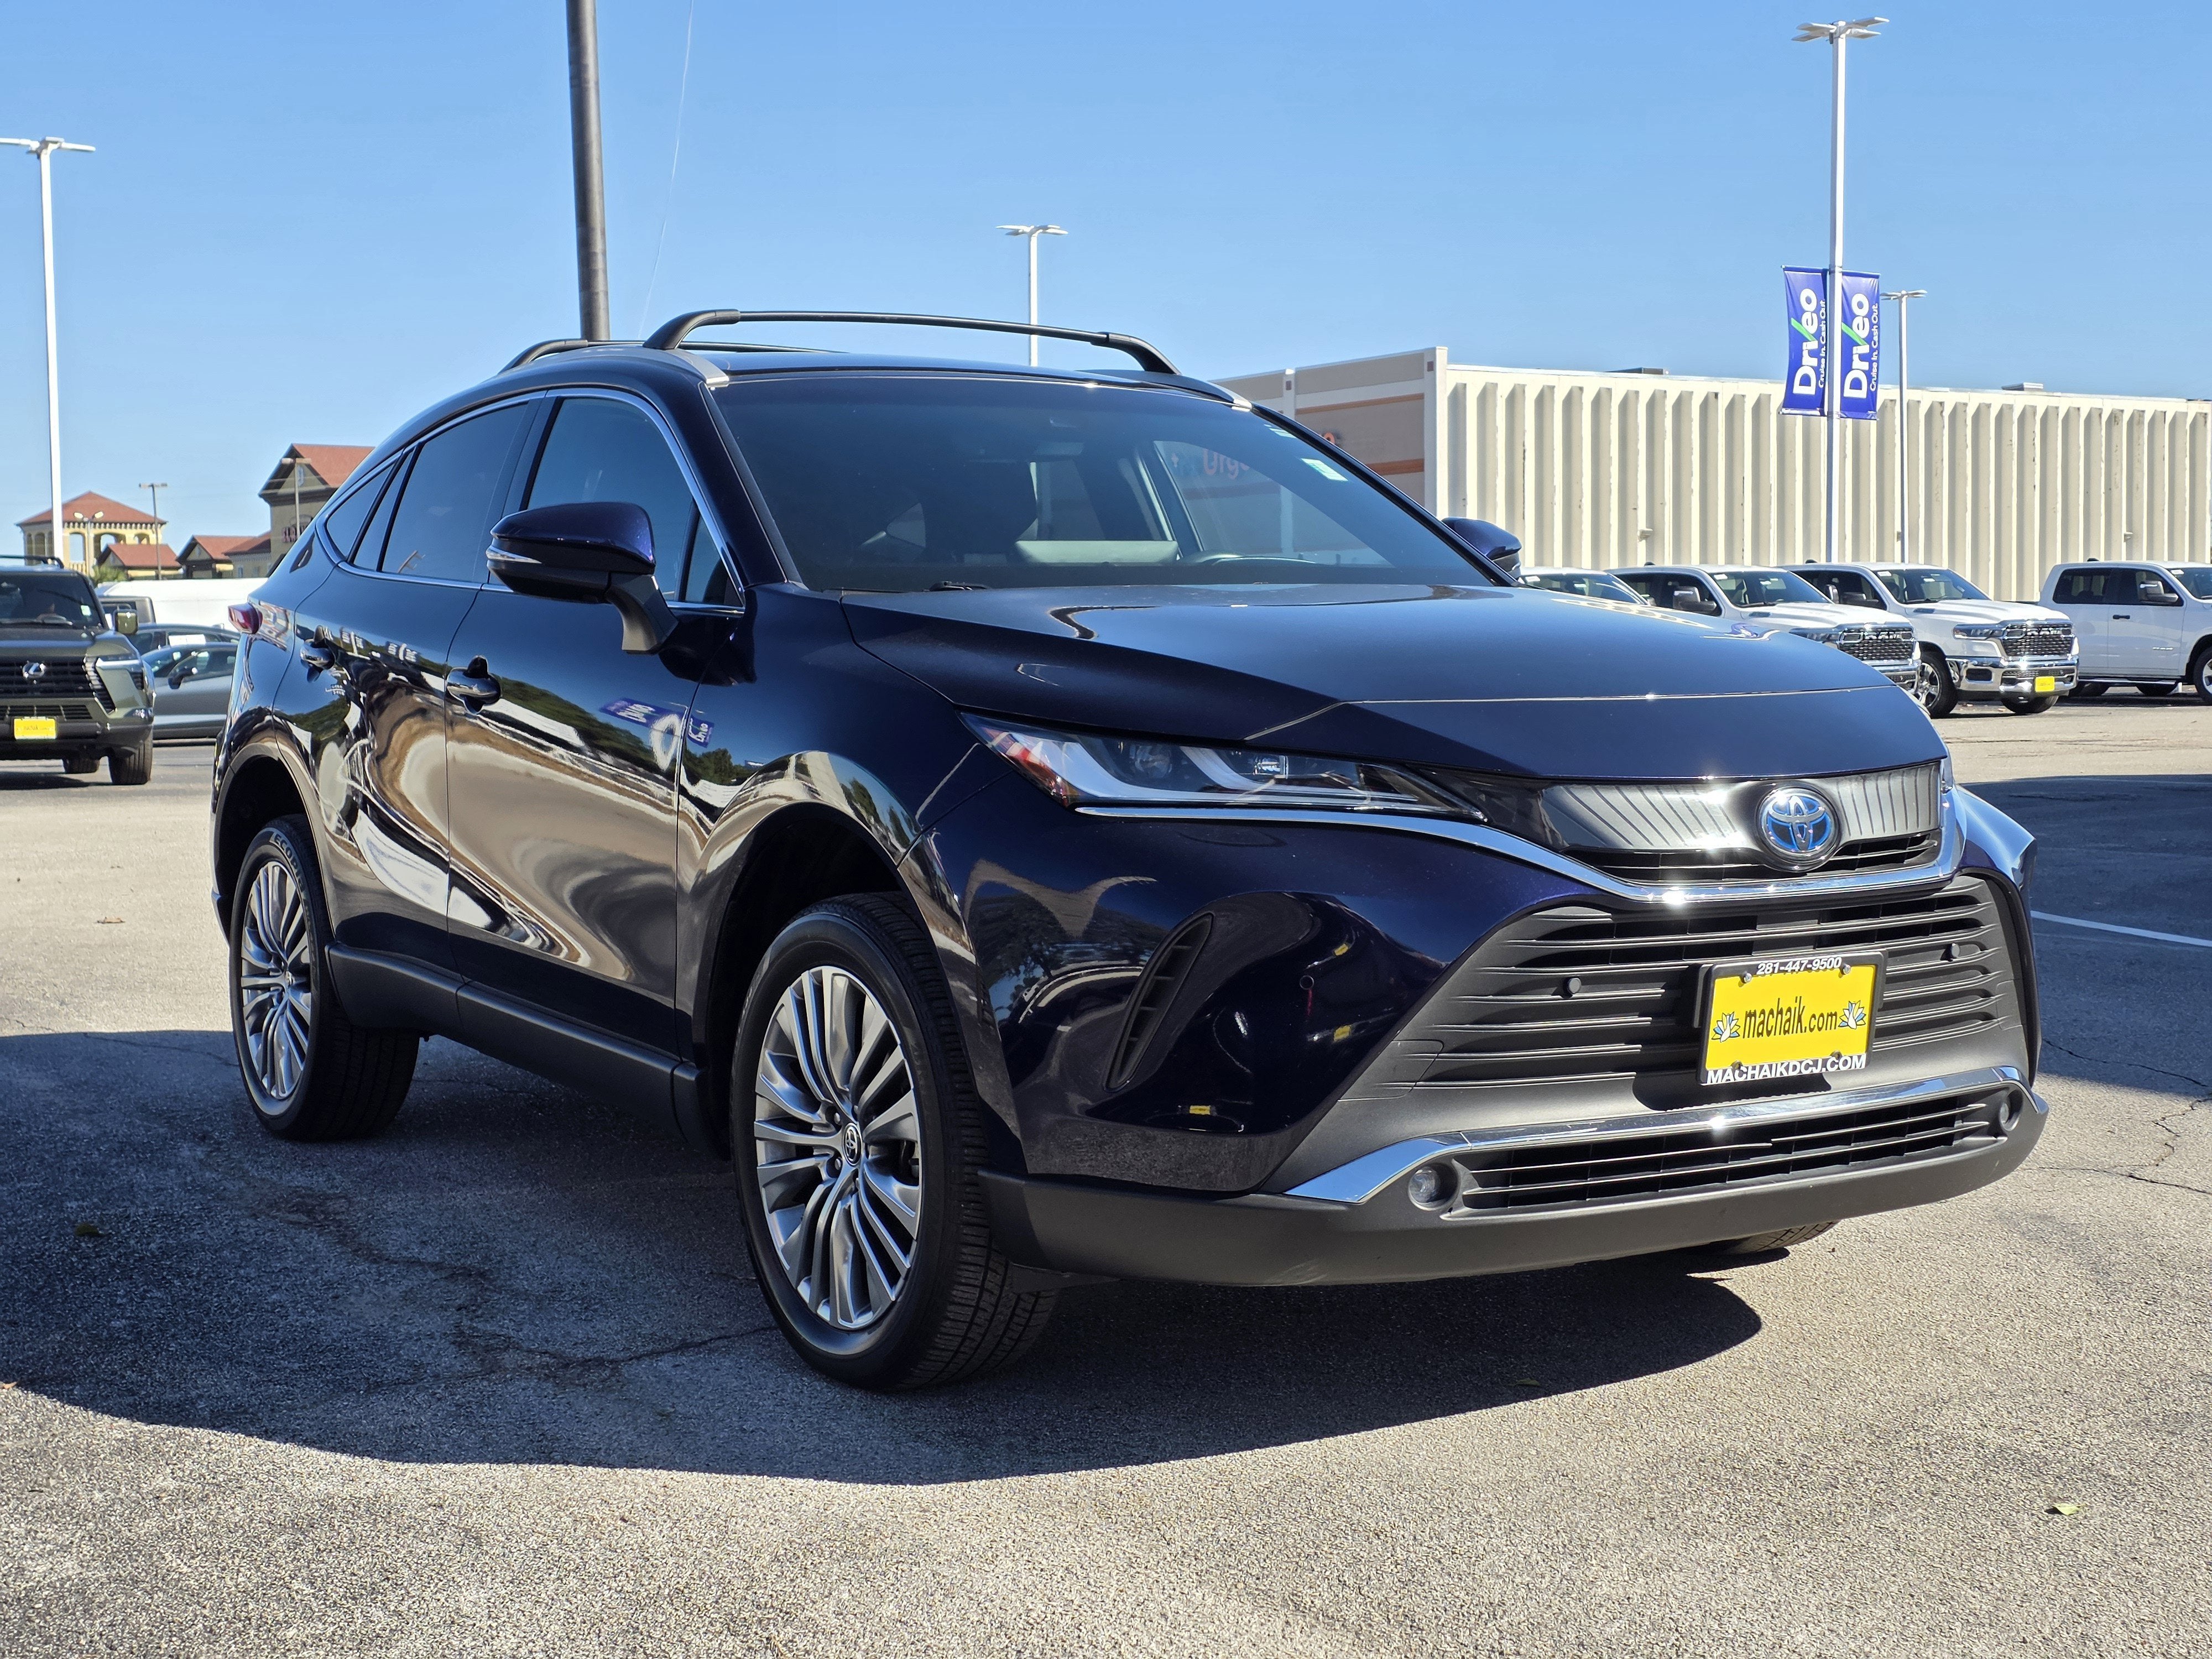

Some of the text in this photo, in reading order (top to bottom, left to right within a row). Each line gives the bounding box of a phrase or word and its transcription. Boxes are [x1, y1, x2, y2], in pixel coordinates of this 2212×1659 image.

[1756, 956, 1842, 975] 281-447-9500
[1742, 996, 1838, 1039] machaik.com
[1707, 1055, 1866, 1084] MACHAIKDCJ.COM
